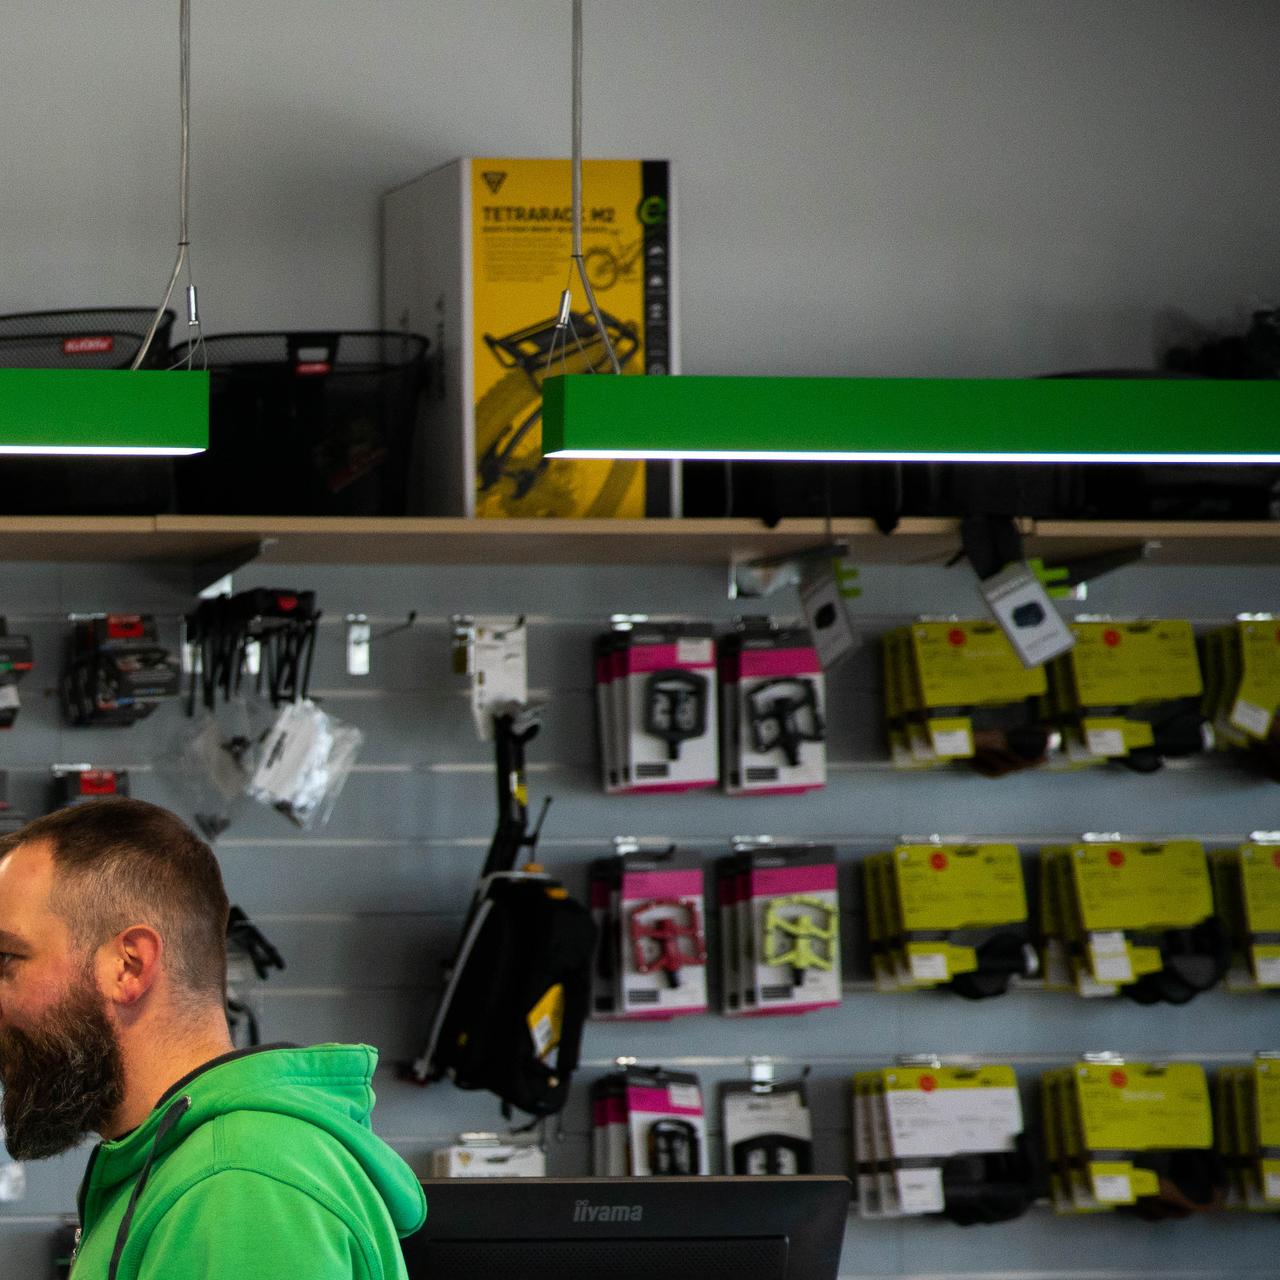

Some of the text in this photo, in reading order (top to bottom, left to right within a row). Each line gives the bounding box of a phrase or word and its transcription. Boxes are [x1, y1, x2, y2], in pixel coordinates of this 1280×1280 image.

[483, 206, 615, 222] TETRARAC M2
[573, 1199, 643, 1222] iiyama
